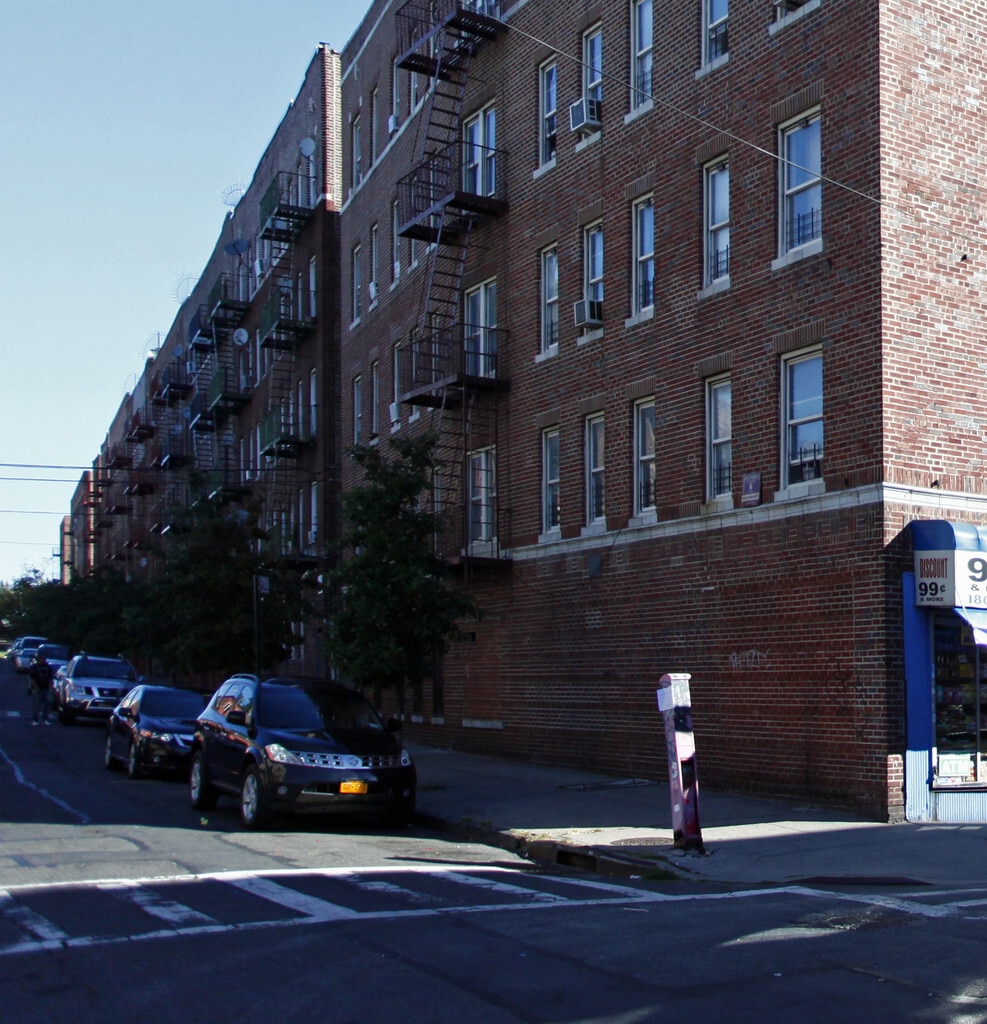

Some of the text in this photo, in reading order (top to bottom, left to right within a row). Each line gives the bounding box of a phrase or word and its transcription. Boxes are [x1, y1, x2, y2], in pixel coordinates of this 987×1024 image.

[919, 557, 948, 580] DISCOUNT
[918, 581, 946, 596] 99¢
[970, 583, 980, 592] &
[942, 760, 968, 774] ATM
